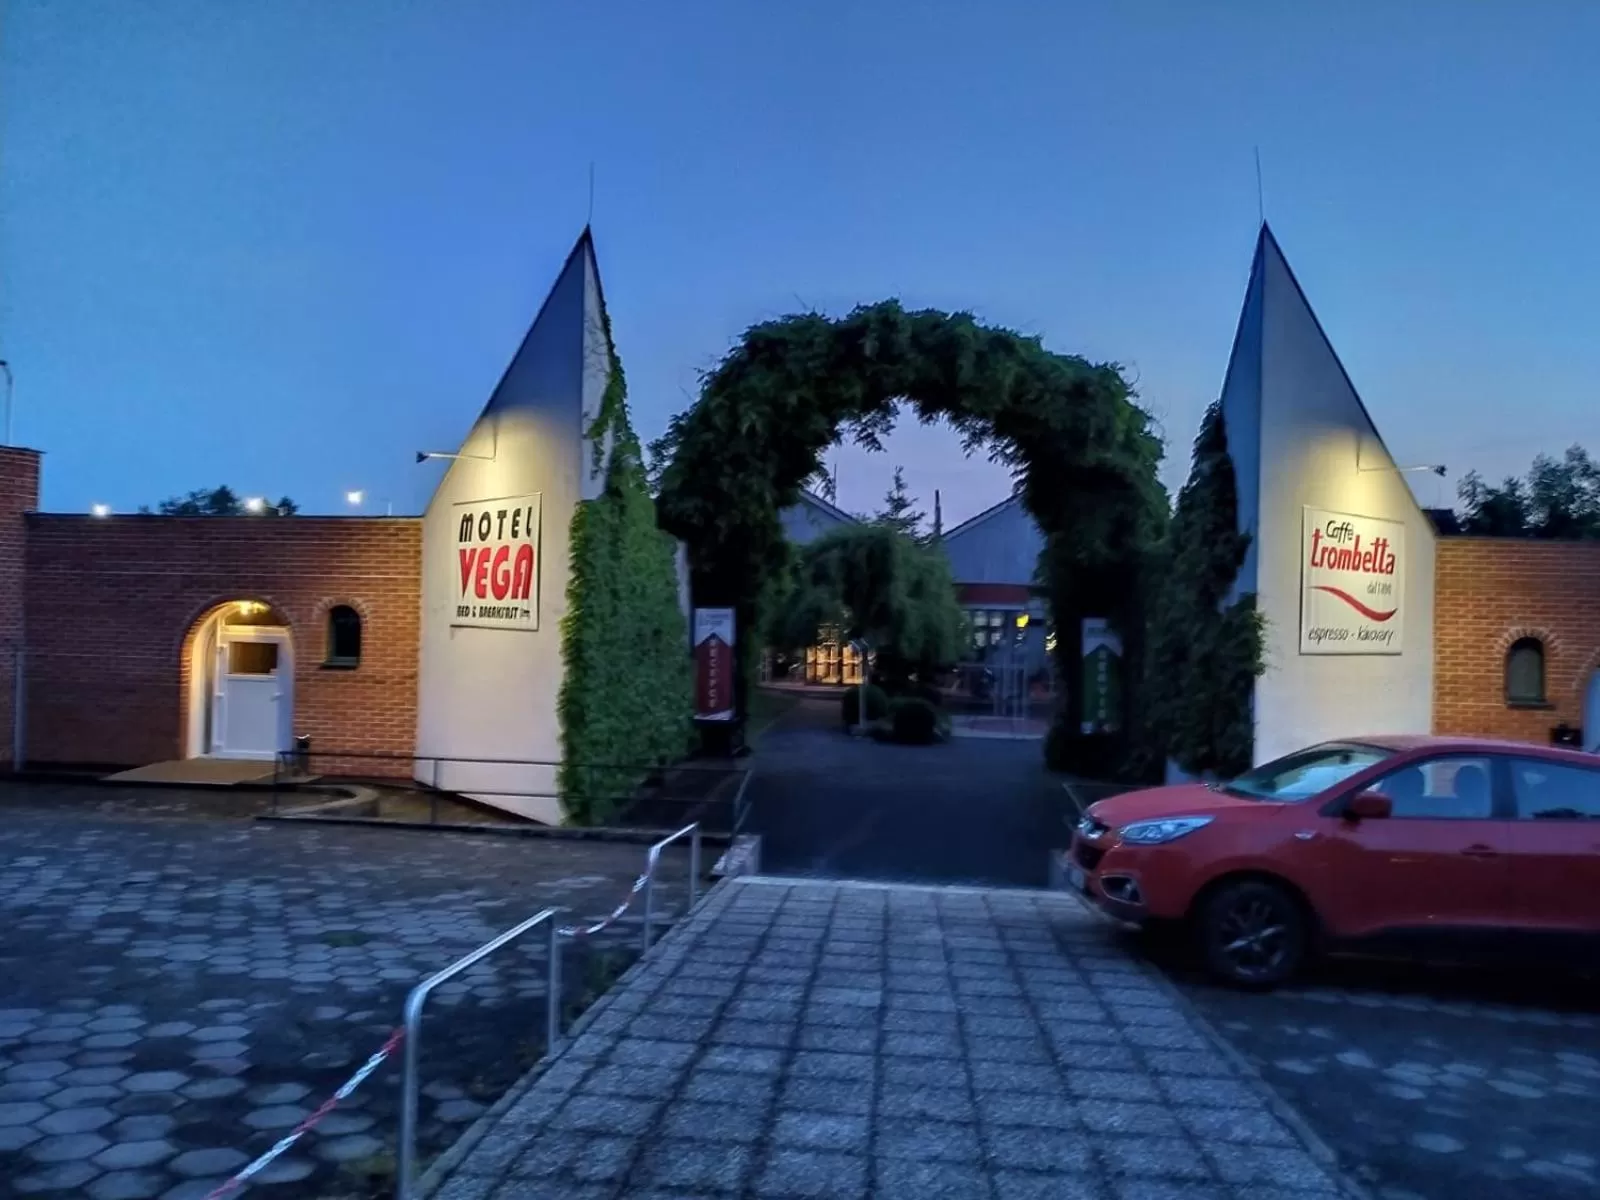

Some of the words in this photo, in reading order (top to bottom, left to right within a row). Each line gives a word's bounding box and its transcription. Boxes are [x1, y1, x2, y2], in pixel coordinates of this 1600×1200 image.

[459, 506, 533, 542] MOTEL
[1310, 528, 1396, 575] trombetta
[458, 543, 534, 601] VEGA
[457, 605, 470, 617] BED
[479, 605, 519, 619] BREAKFAST
[1308, 627, 1349, 646] espresso
